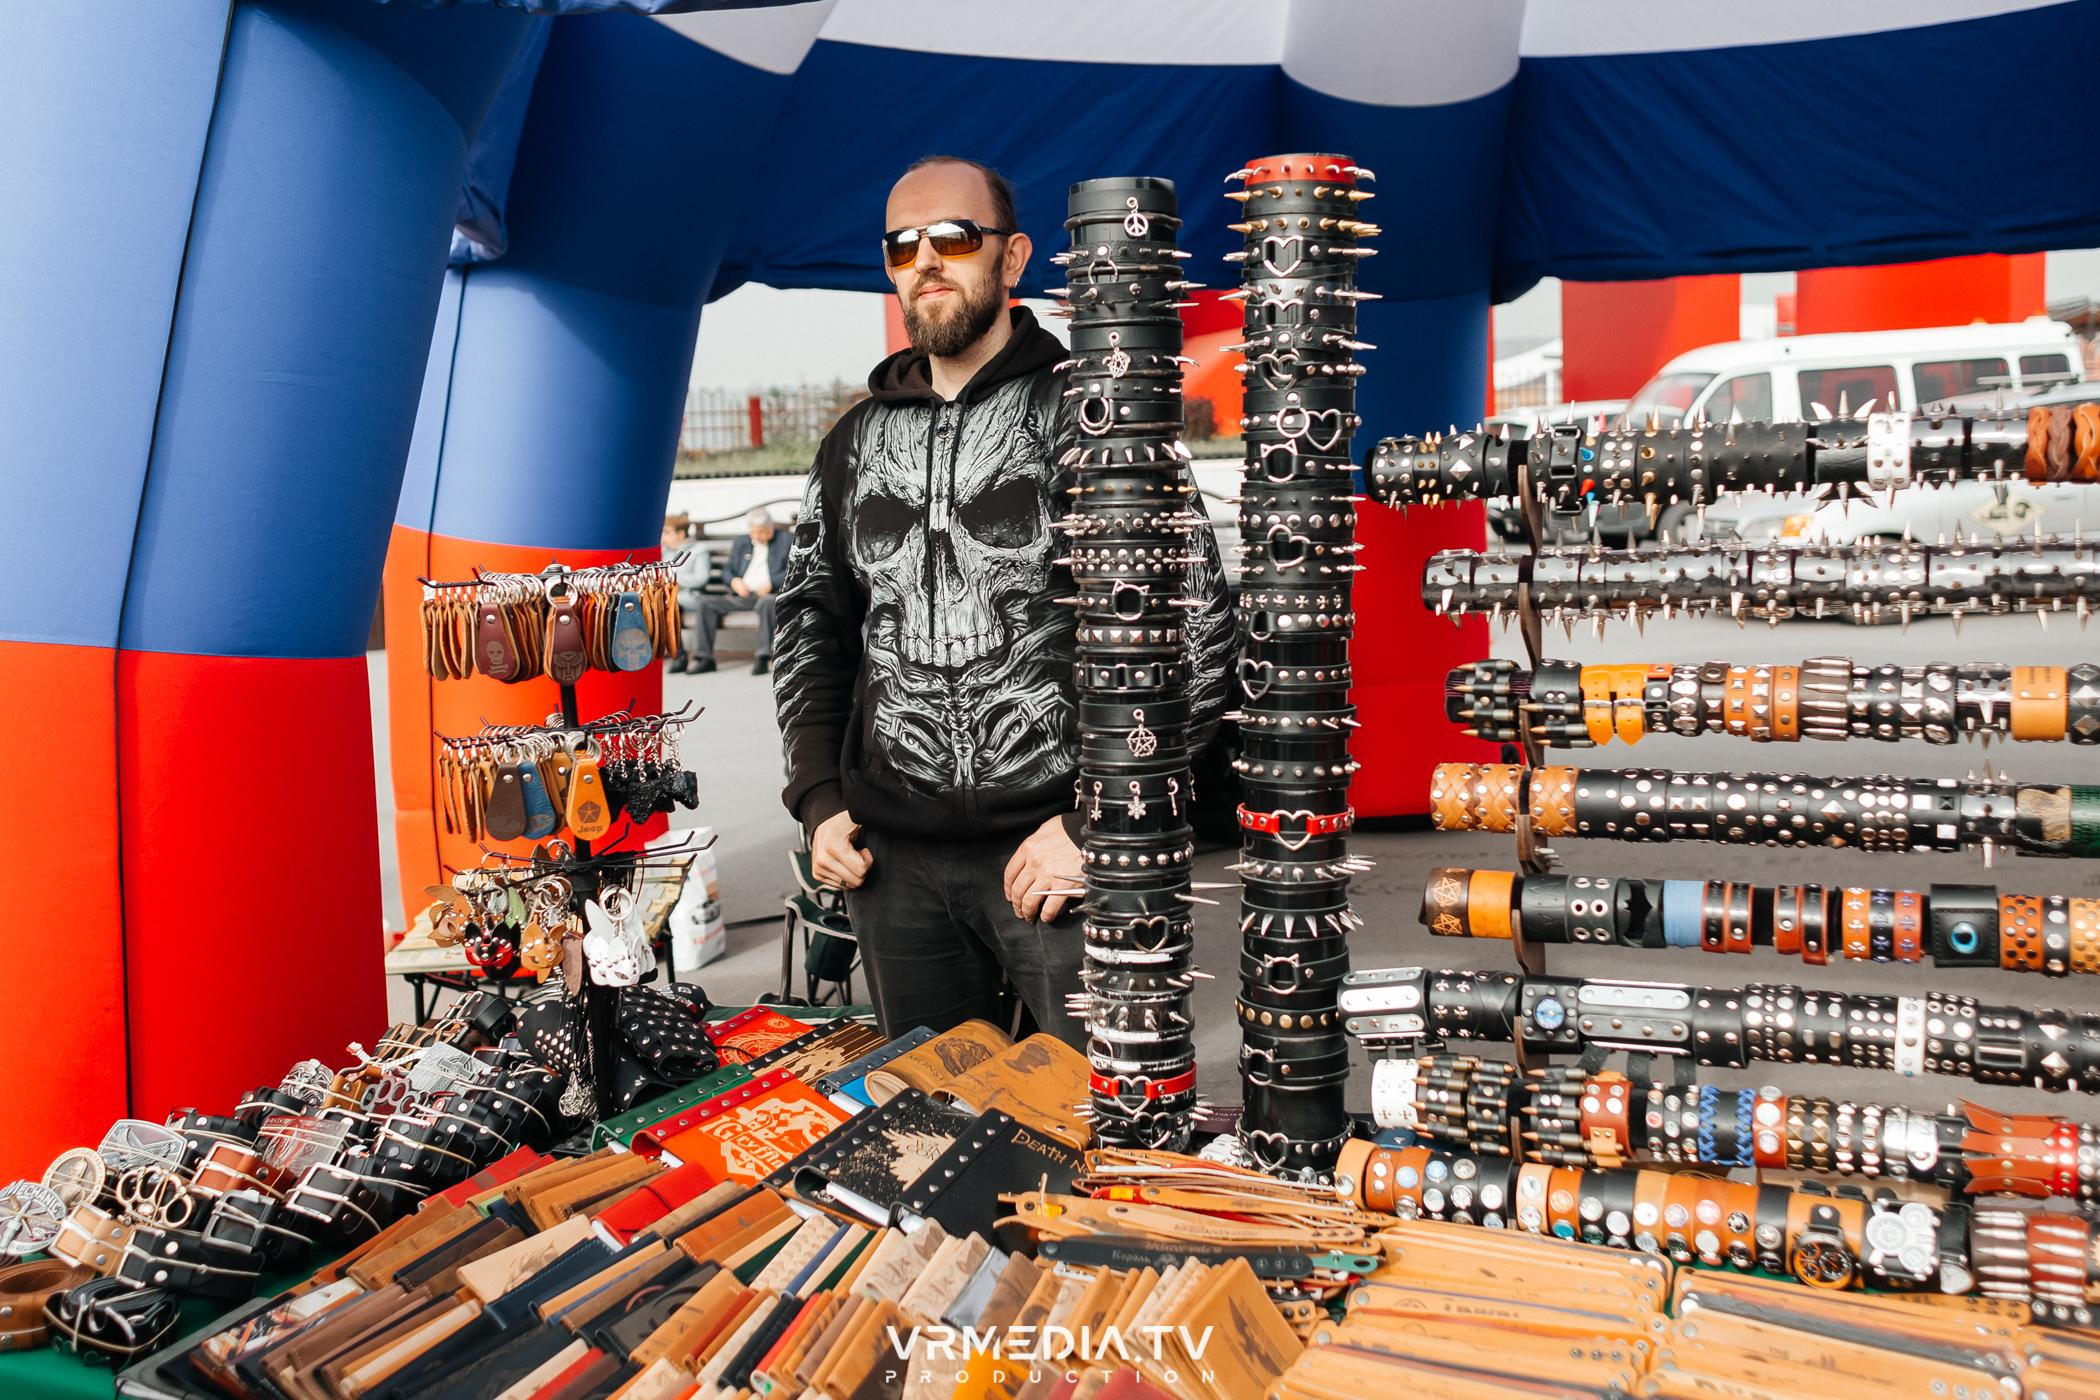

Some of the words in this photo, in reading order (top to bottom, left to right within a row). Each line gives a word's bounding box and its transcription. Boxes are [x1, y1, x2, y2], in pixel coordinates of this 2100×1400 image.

[712, 1119, 785, 1170] Gryffin
[1010, 1128, 1068, 1165] DEATH
[1069, 1158, 1090, 1176] No
